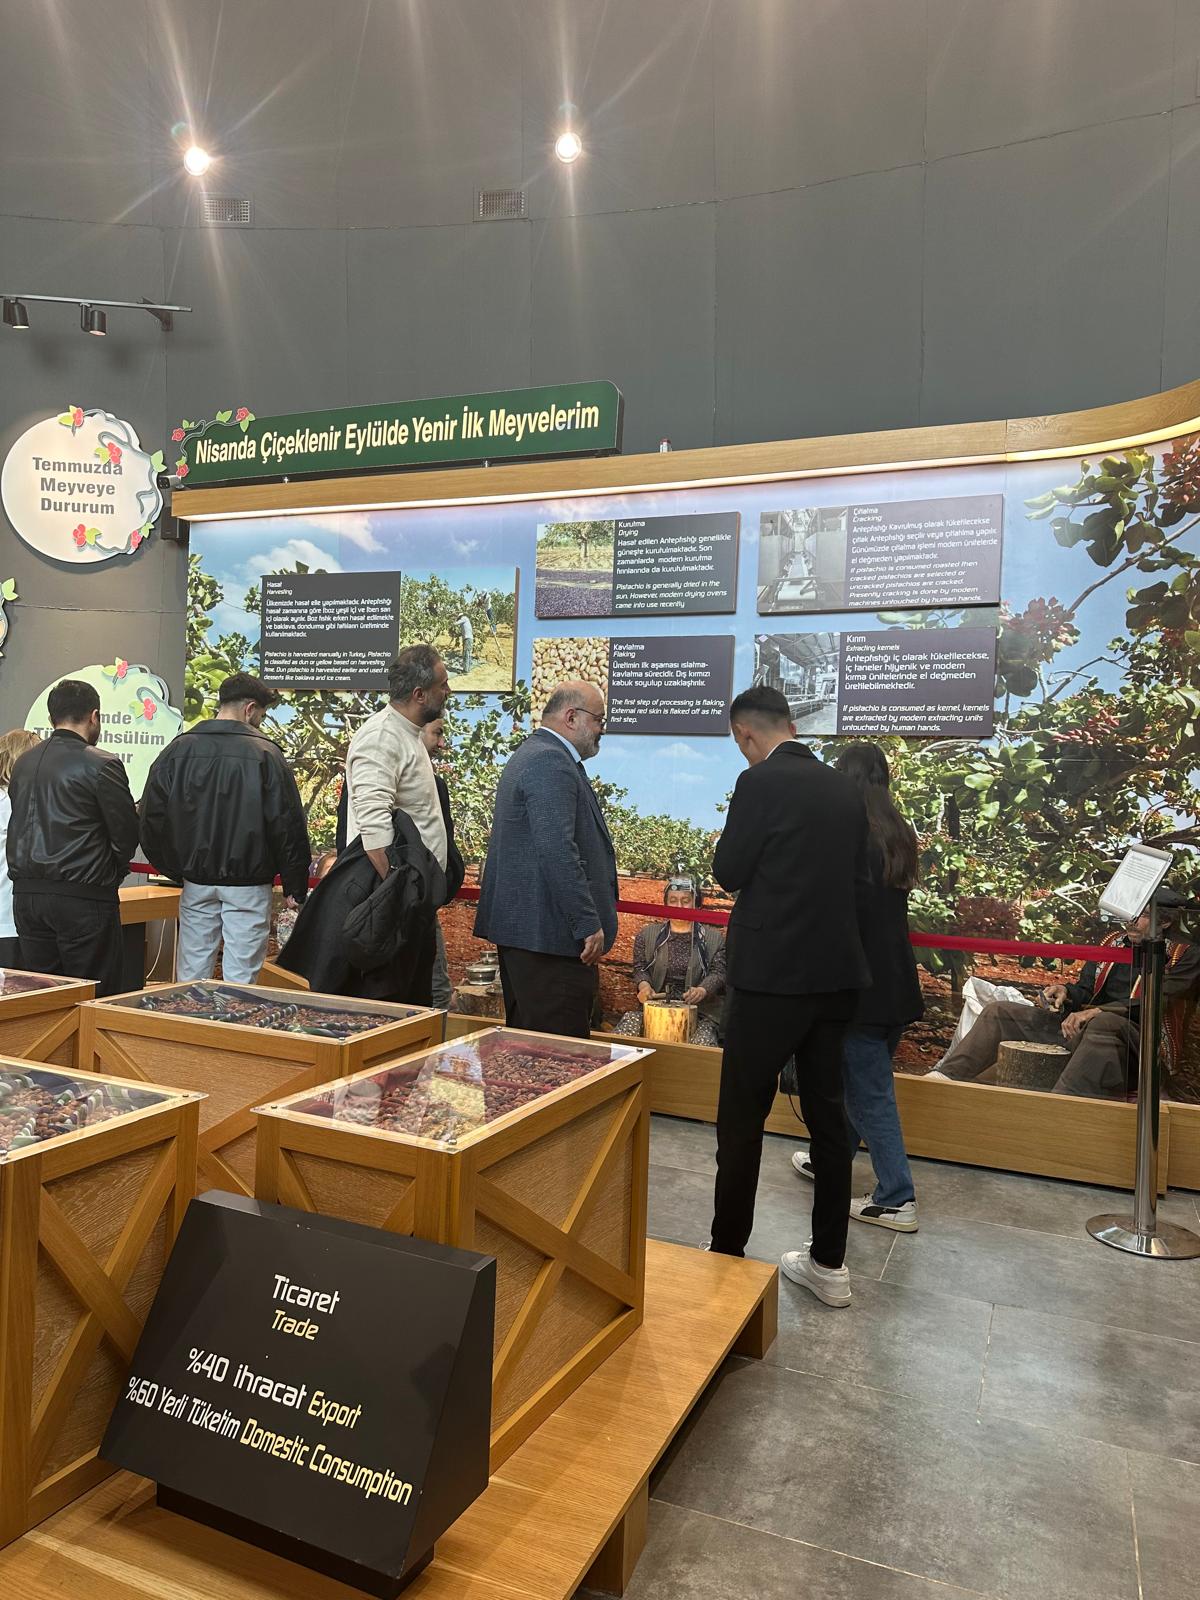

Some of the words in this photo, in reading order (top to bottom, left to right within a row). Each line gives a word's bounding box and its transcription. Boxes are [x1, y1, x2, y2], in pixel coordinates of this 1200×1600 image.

[196, 435, 256, 464] Nisanda
[260, 425, 341, 464] Çiçeklenir
[344, 419, 408, 455] Eylülde
[412, 414, 457, 443] Yenir
[461, 406, 485, 439] İlk
[488, 401, 599, 442] Meyvelerim
[32, 457, 123, 475] Temmuzda
[41, 477, 115, 497] Meyveye
[41, 497, 115, 514] Dururum
[699, 534, 732, 544] genellikle
[618, 549, 644, 557] güneşte
[652, 582, 683, 590] generally
[613, 651, 636, 659] Flaking
[893, 654, 900, 663] iç
[902, 653, 928, 661] olarak
[613, 661, 640, 669] Üretimin
[846, 665, 852, 673] iç
[885, 663, 917, 672] hijyenik
[933, 662, 965, 670] modern
[676, 671, 687, 679] Dış
[845, 673, 867, 681] kırma
[920, 672, 928, 680] el
[930, 672, 976, 681] değmeden
[635, 680, 663, 688] soyulup
[637, 699, 651, 707] step
[848, 705, 880, 713] pistachio
[888, 715, 899, 723] by
[928, 715, 964, 723] extracting
[880, 724, 890, 732] by
[271, 1274, 340, 1314] Ticaret
[271, 1309, 319, 1341] Trade
[186, 1348, 230, 1382] %40
[232, 1363, 307, 1409] ihracat
[307, 1390, 362, 1429] Export
[125, 1376, 159, 1408] %60
[157, 1386, 189, 1419] Yerli
[186, 1397, 241, 1440] Tüketim
[239, 1418, 310, 1466] Domestic
[308, 1443, 413, 1506] Consumption
